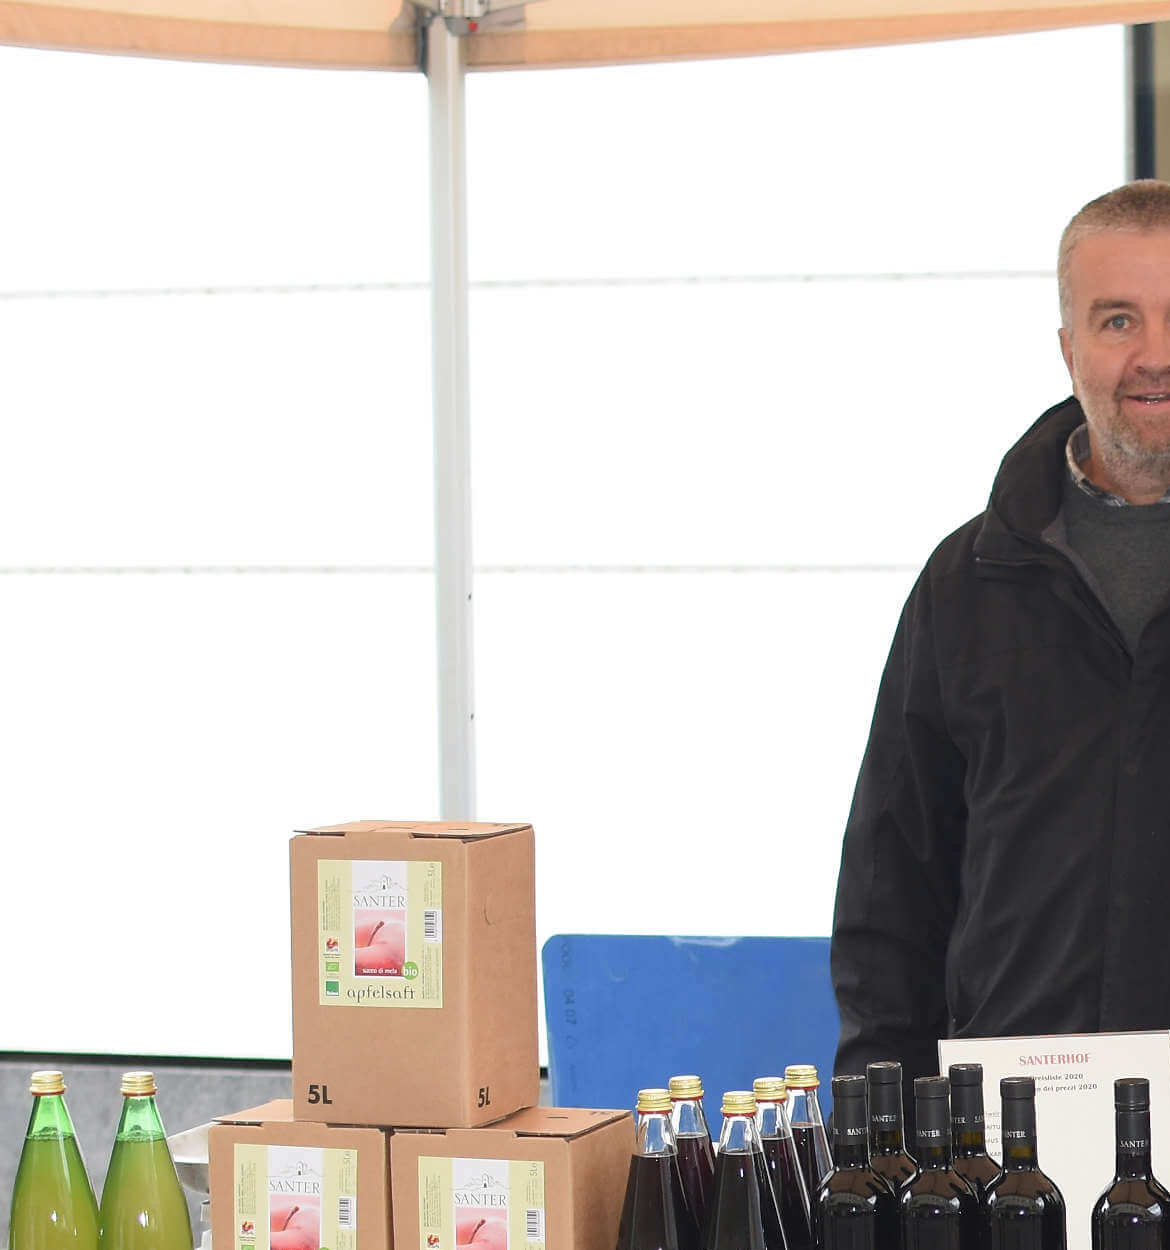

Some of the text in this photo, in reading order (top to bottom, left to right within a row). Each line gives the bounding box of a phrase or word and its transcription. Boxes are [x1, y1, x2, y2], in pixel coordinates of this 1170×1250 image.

[353, 894, 405, 908] SANTER
[404, 966, 418, 975] bio
[347, 985, 416, 1003] apfelsaft
[308, 1085, 332, 1105] 5L
[478, 1087, 490, 1108] 5L
[269, 1179, 320, 1194] SANTER
[454, 1193, 506, 1207] SANTER
